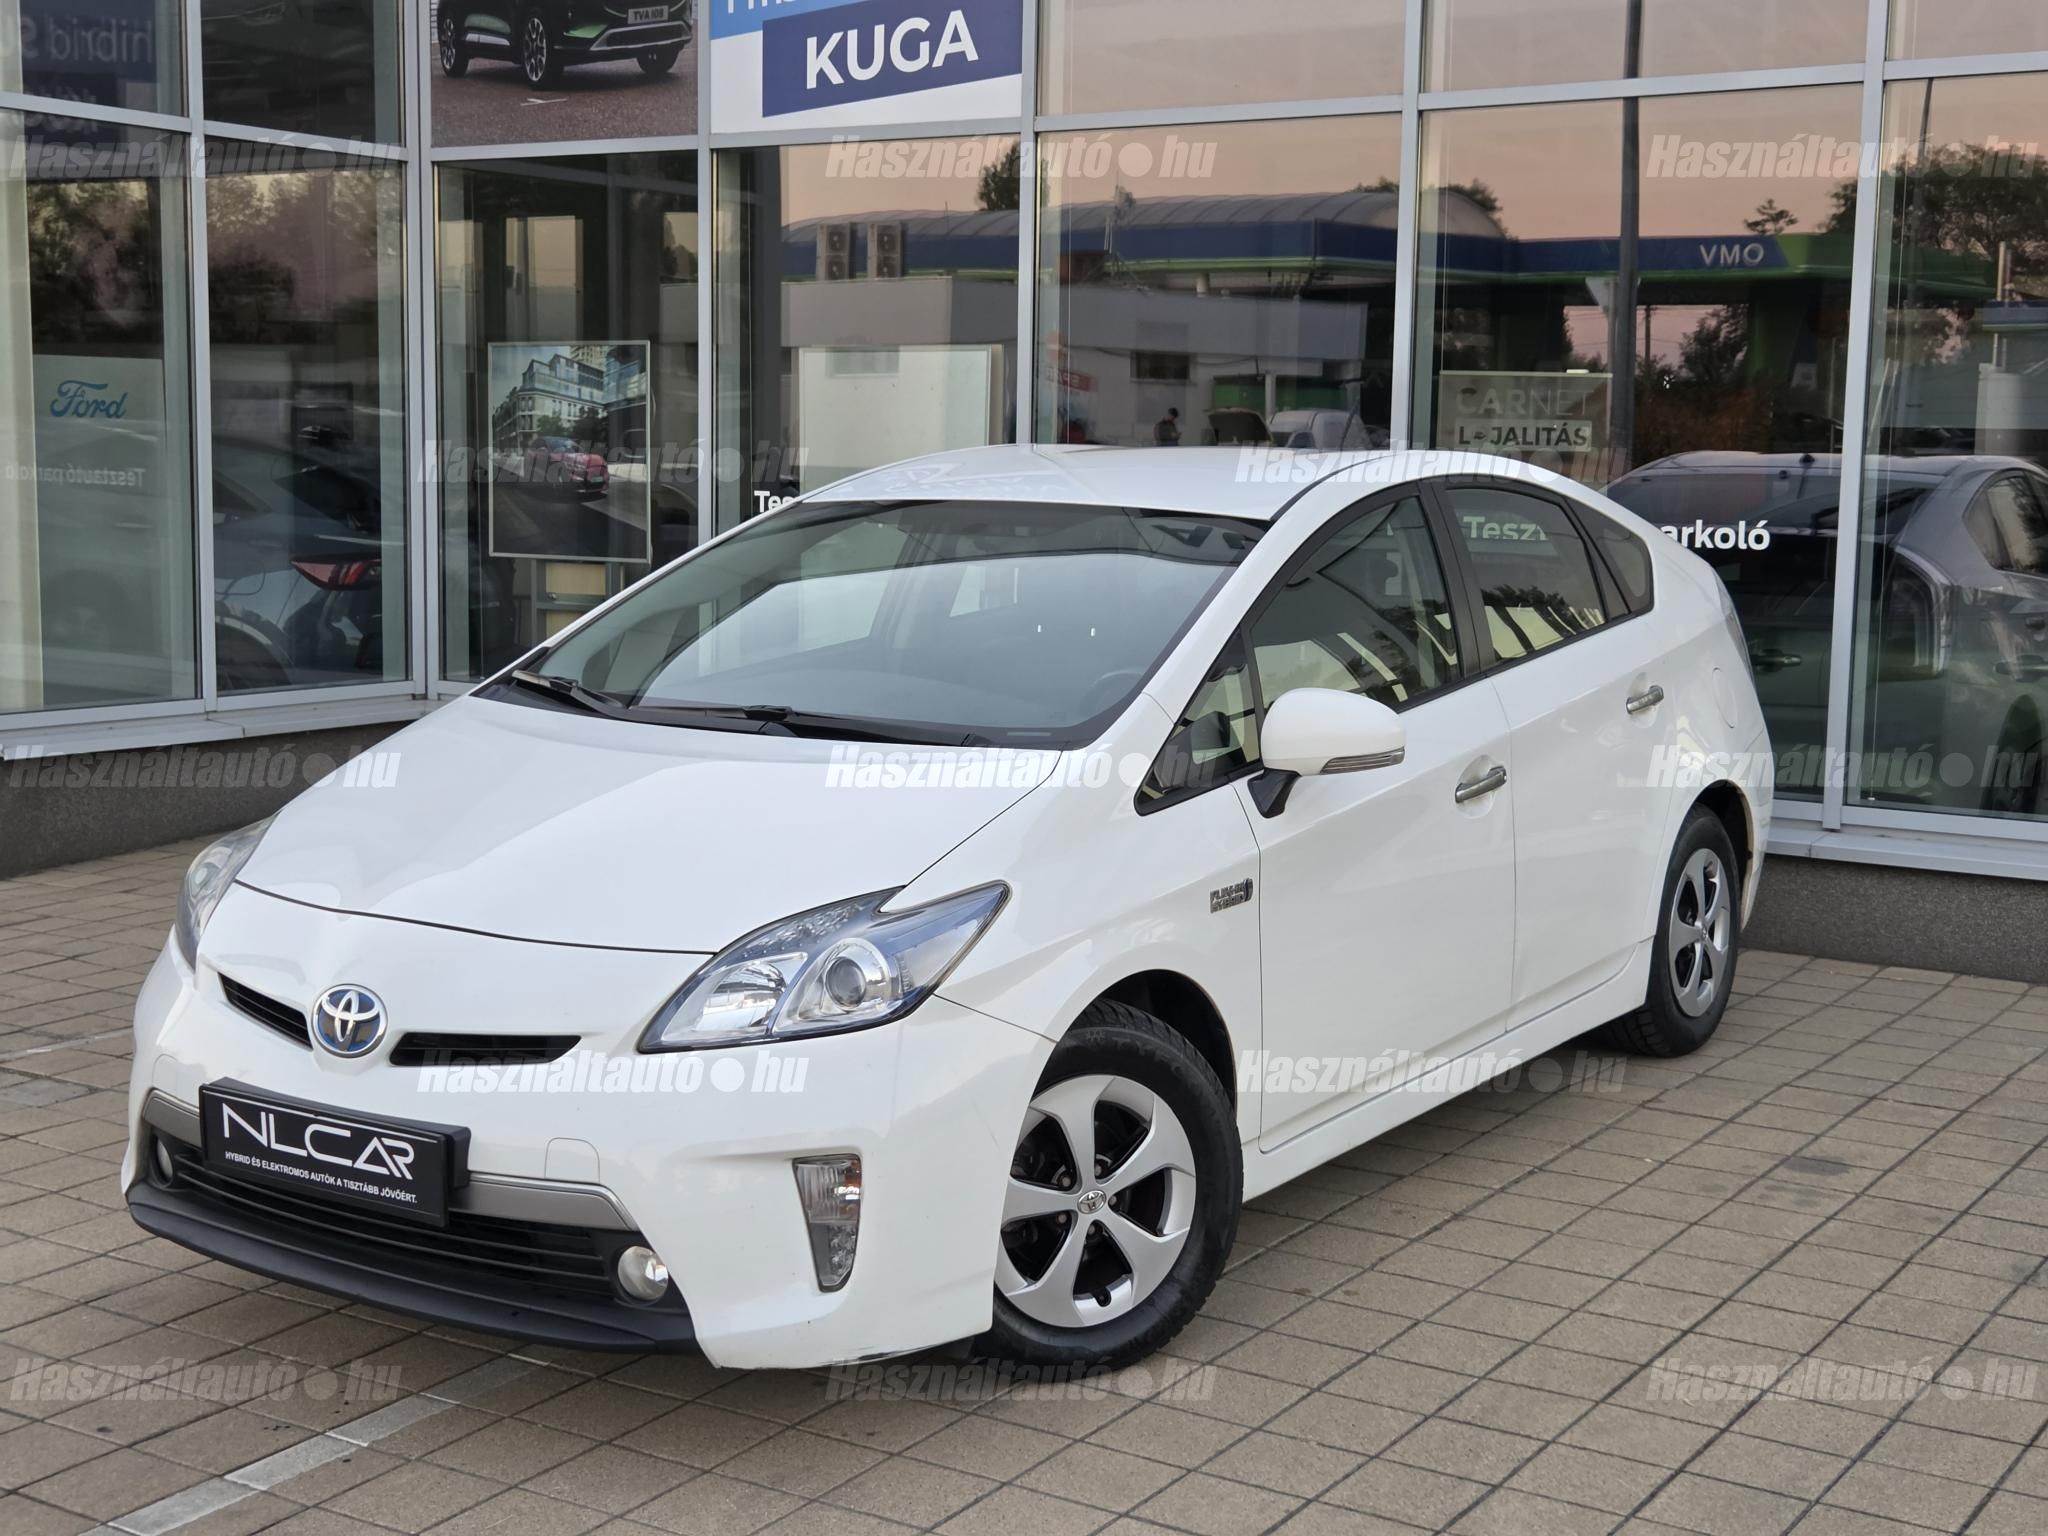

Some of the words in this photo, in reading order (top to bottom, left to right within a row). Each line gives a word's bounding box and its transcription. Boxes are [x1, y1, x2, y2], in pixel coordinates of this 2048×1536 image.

[805, 8, 980, 90] KUGA
[50, 379, 128, 419] Ford
[225, 1150, 251, 1165] HYBRID
[251, 1151, 261, 1169] ÉS
[262, 1160, 309, 1180] ELEKTROMOS
[310, 1171, 335, 1186] AUTÓK
[336, 1178, 343, 1187] A
[343, 1178, 379, 1196] TISZTÁBB
